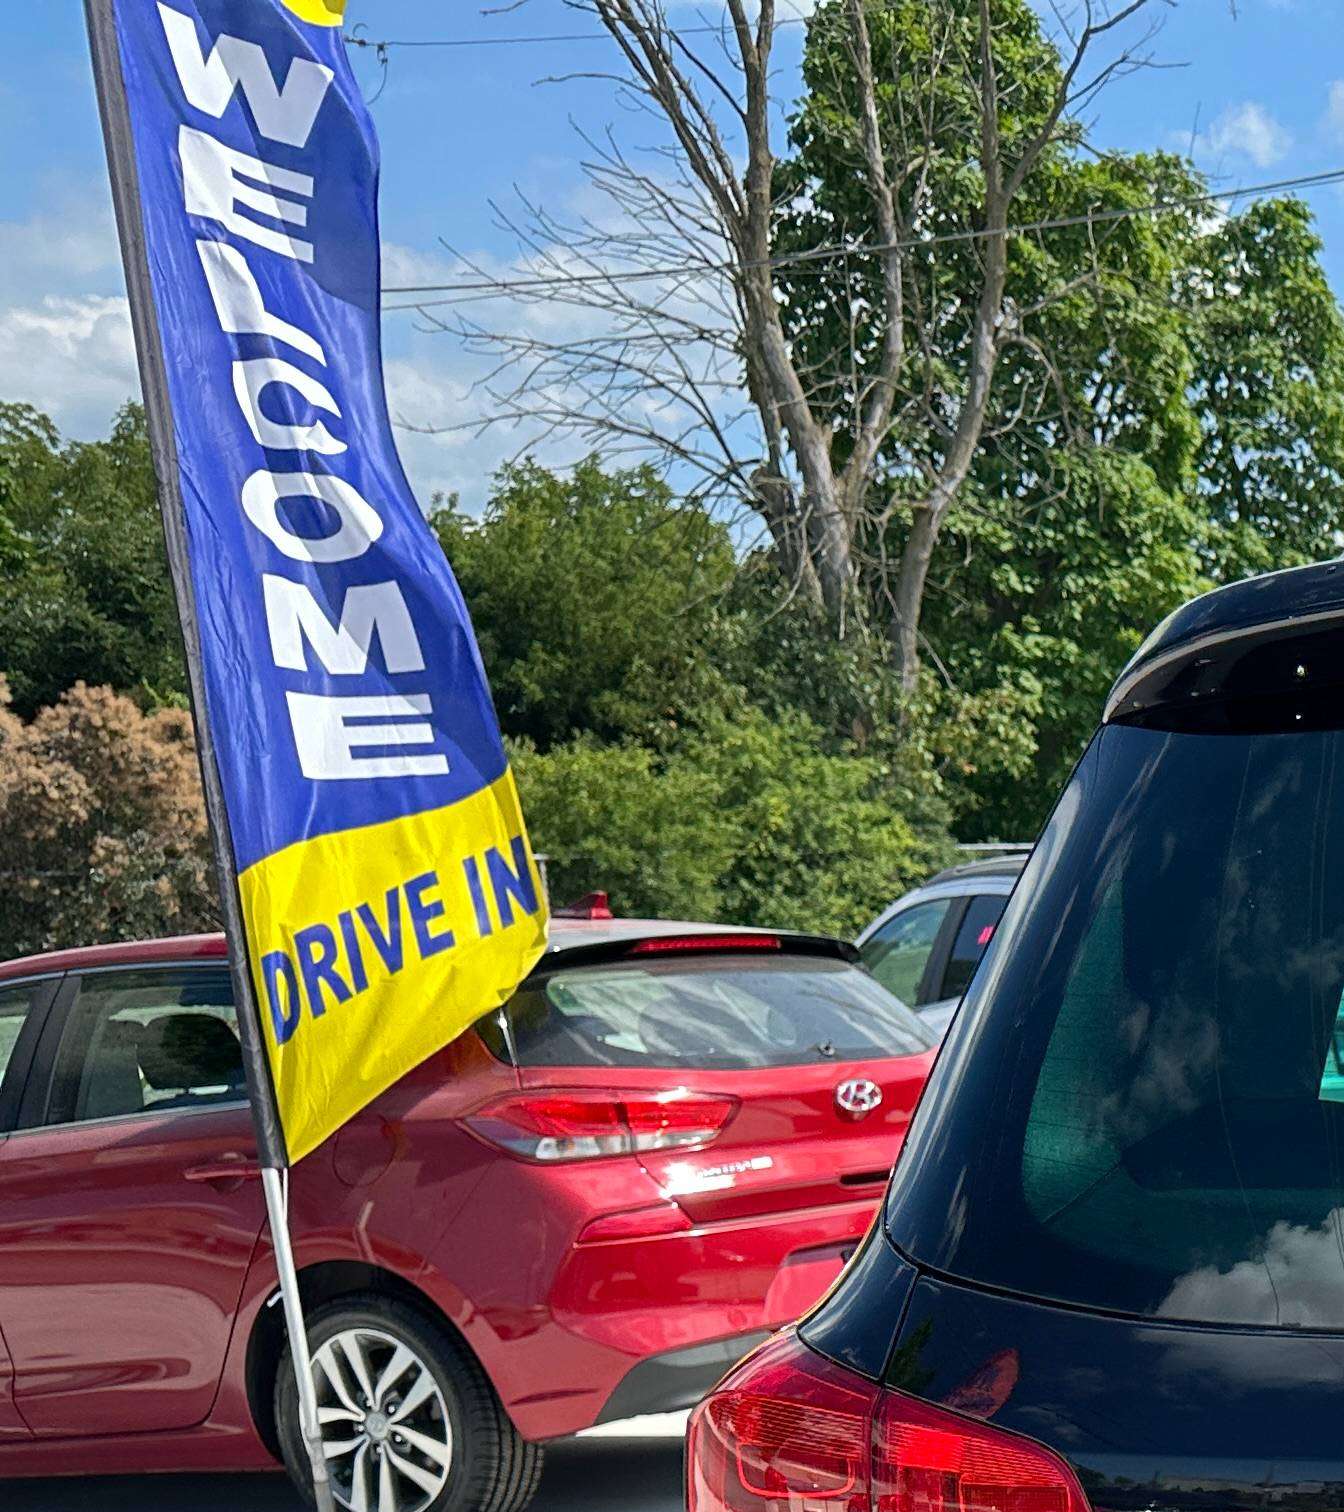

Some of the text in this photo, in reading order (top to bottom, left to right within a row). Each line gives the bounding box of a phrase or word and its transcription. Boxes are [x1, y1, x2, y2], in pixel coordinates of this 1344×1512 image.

[157, 2, 450, 781] WELCOME
[260, 835, 539, 1046] DRIVE IN
